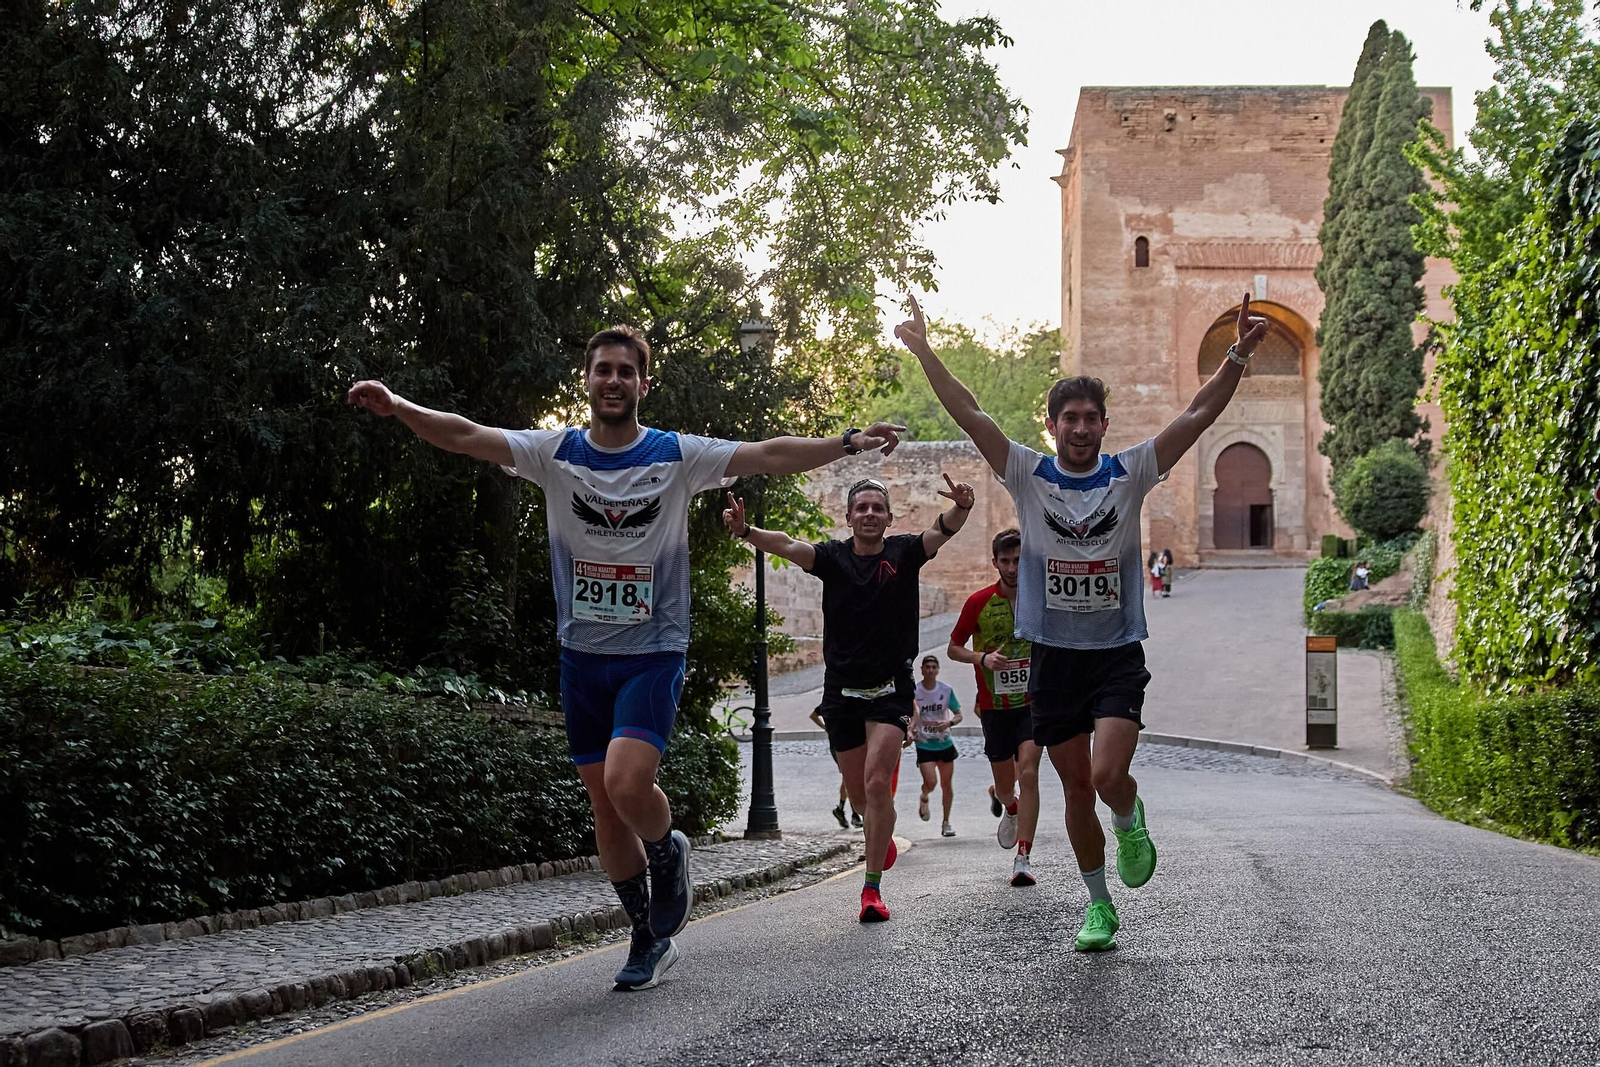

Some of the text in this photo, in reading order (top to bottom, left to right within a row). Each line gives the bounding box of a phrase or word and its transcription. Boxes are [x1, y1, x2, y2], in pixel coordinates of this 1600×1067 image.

[584, 493, 650, 508] VALDEPEÑAS
[1053, 508, 1107, 526] VALDEAS
[585, 528, 646, 539] ATHLETICS CLUB
[576, 562, 587, 576] 41
[1048, 560, 1060, 573] 41
[575, 578, 638, 607] 2918
[1048, 574, 1109, 597] 3019
[1000, 669, 1028, 684] 958
